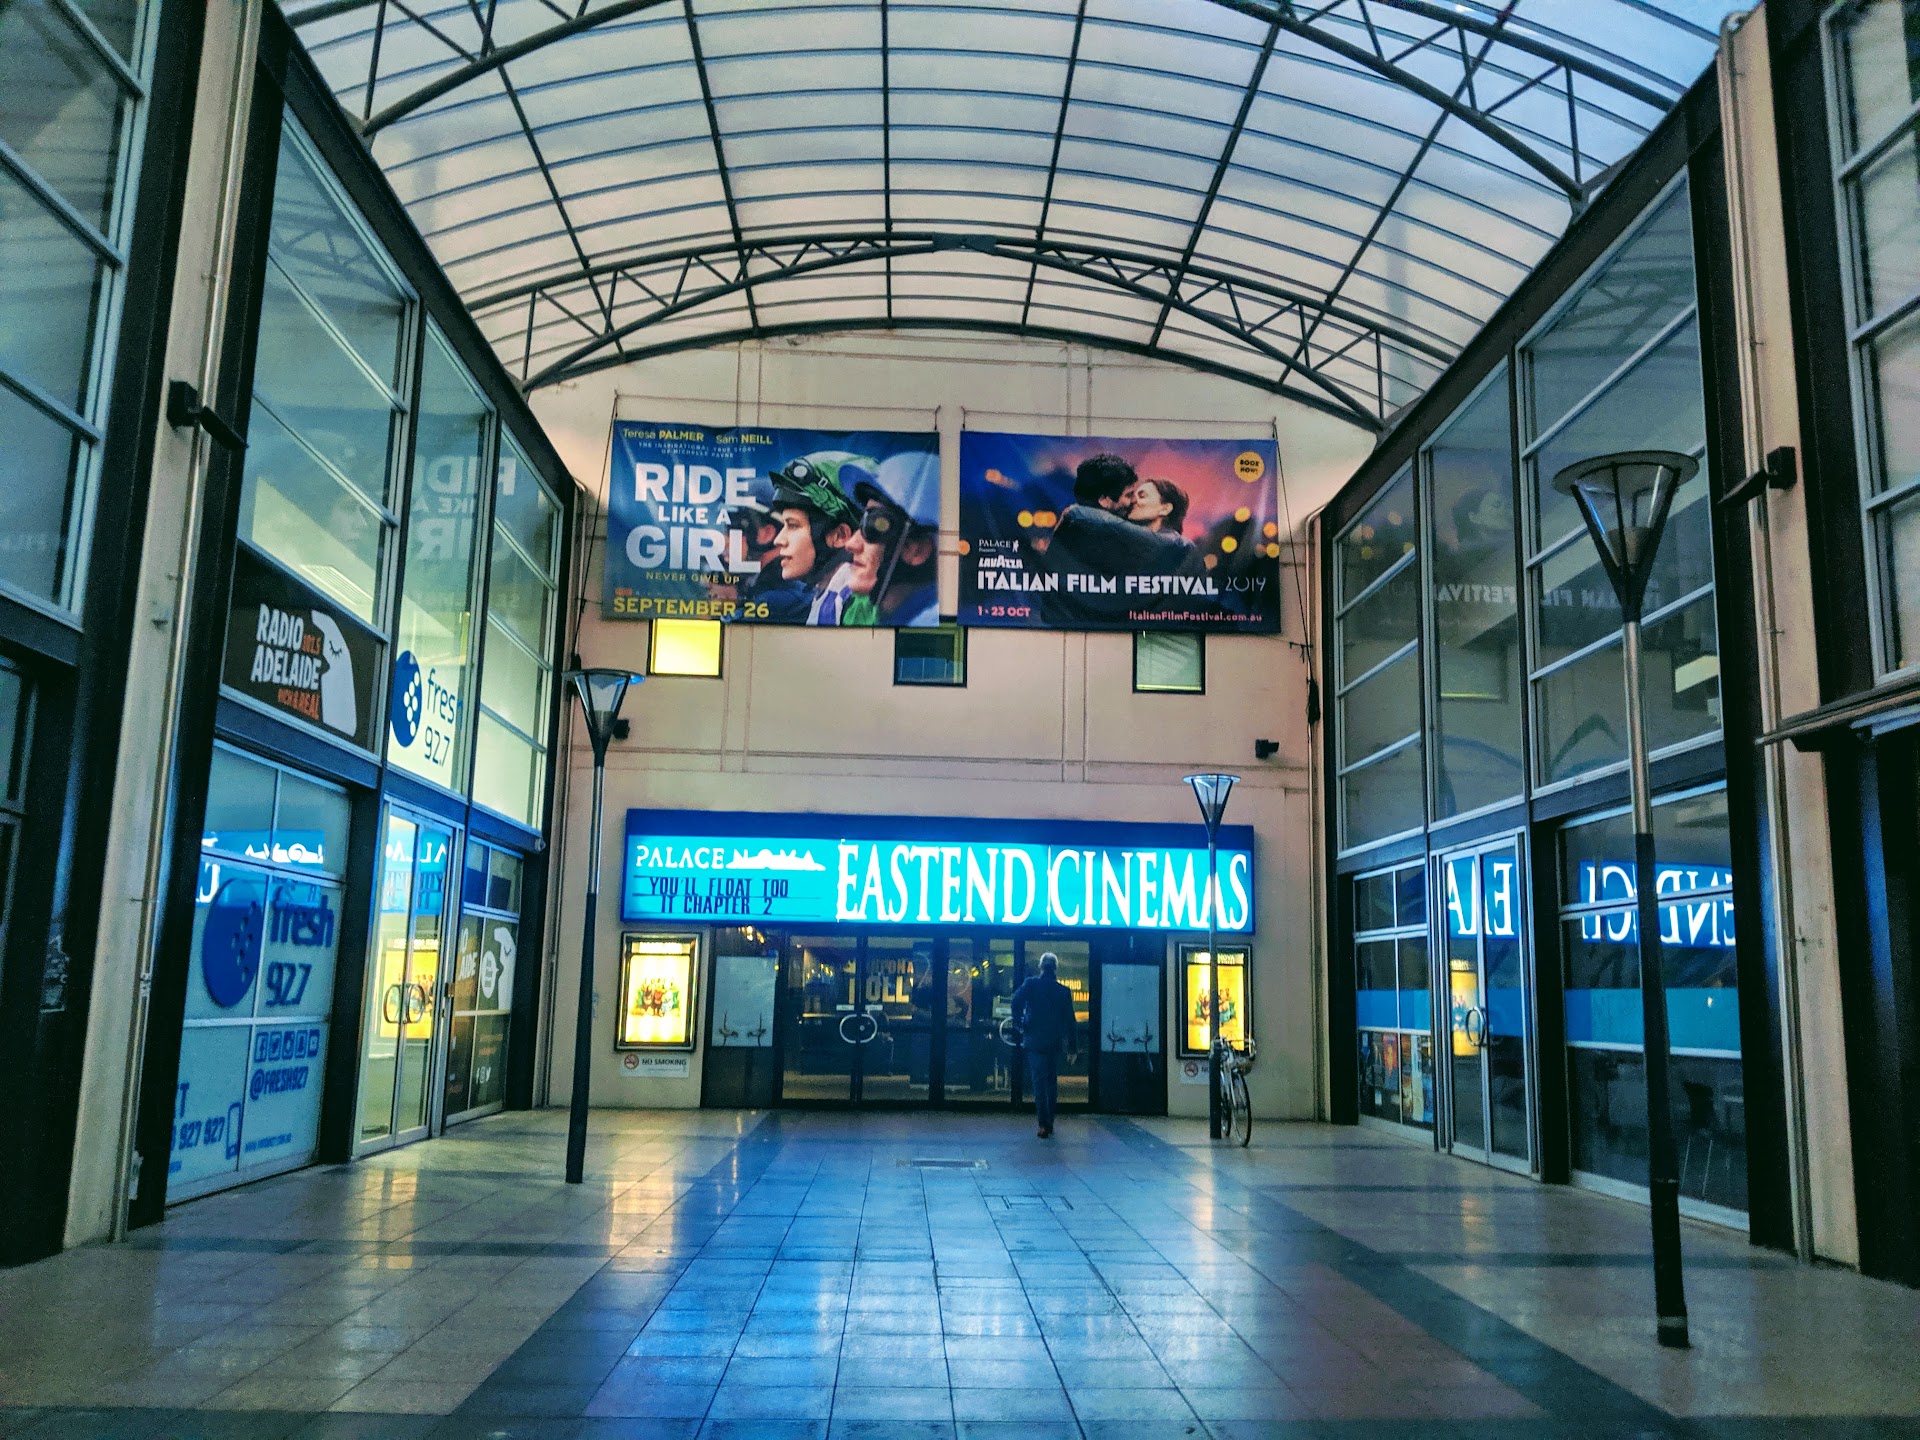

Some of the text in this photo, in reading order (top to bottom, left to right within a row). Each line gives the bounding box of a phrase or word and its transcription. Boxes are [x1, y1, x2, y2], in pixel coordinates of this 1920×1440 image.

[623, 428, 773, 445] Teresa PALMER Sam NEILL
[634, 462, 757, 506] RIDE
[658, 505, 731, 525] LIKE A
[626, 525, 761, 573] GIRL
[979, 539, 1010, 548] PALACE
[646, 571, 740, 585] NEVER GIVE UP
[977, 571, 1266, 596] ITALIAN FILM FESTIVAL 2019
[613, 597, 770, 618] SEPTEMBER 26
[978, 605, 983, 616] 1
[1007, 606, 1030, 617] OCT
[1129, 610, 1263, 622] ItalianFilmFestival.com.au
[256, 603, 304, 651] RADIO
[250, 644, 322, 690] ADELAIDE
[636, 845, 725, 869] PALACE
[650, 876, 789, 898] YOU'LL FLOAT TOO
[836, 842, 1248, 930] EASTEND CINEMAS
[661, 895, 772, 915] IT CHAPTER 2
[270, 885, 334, 948] fresh
